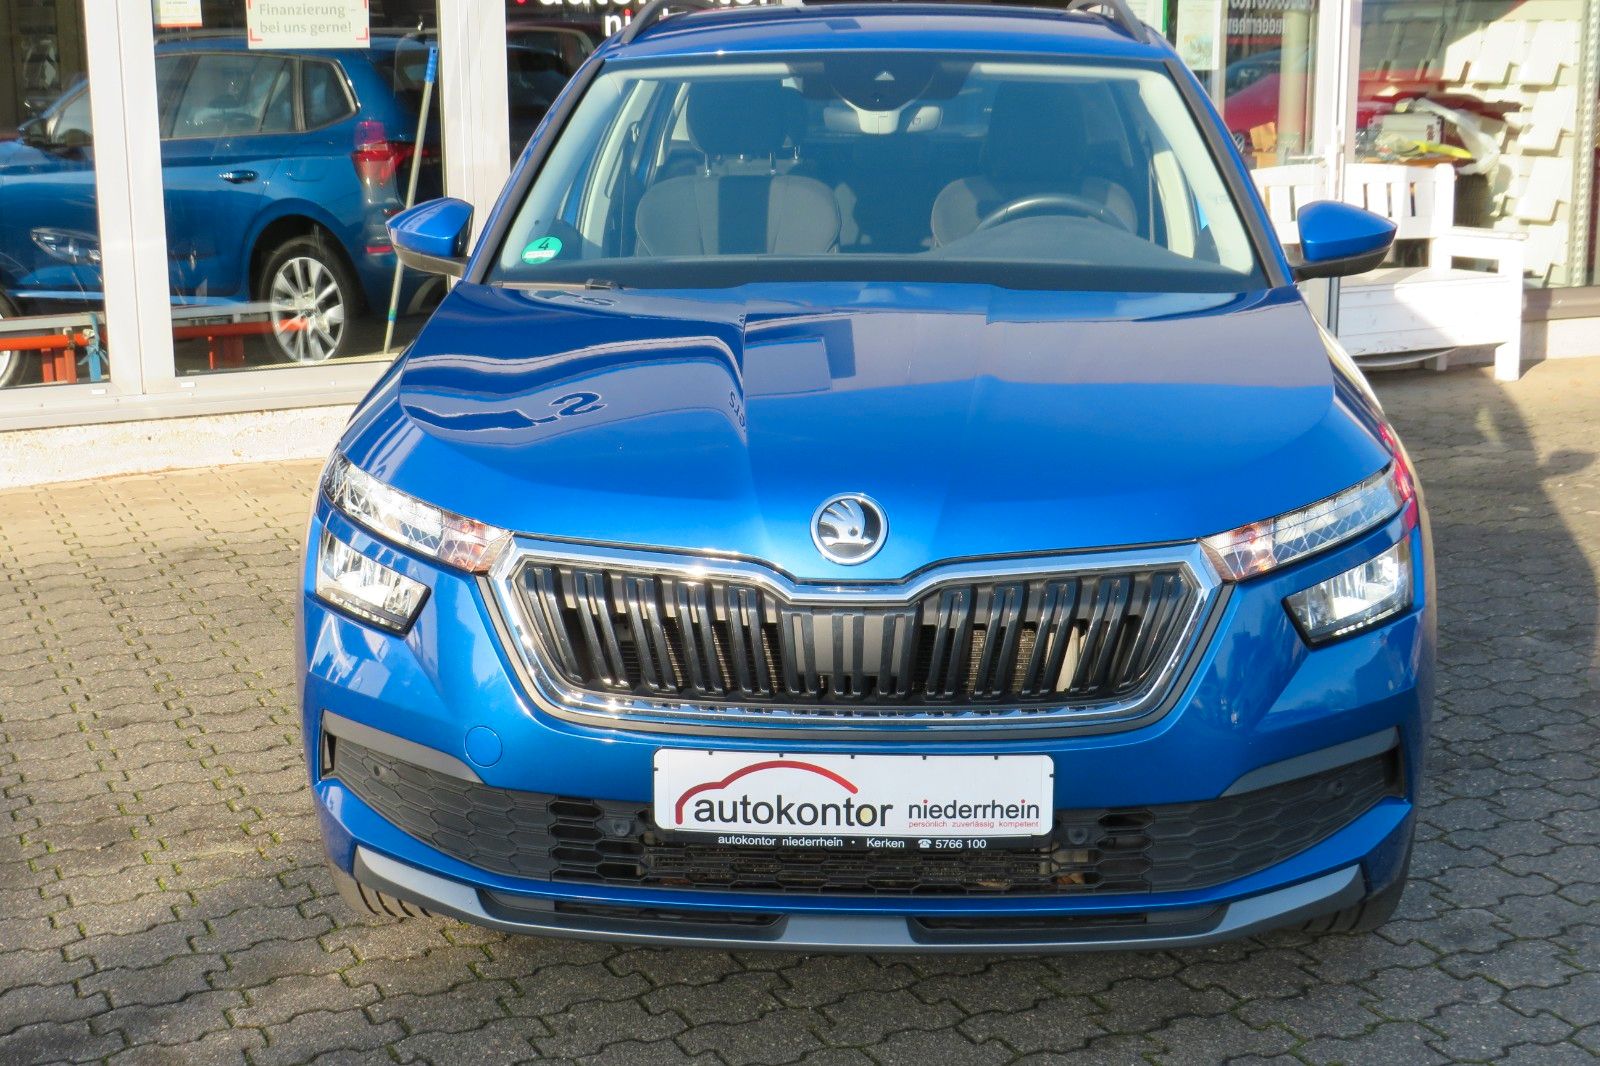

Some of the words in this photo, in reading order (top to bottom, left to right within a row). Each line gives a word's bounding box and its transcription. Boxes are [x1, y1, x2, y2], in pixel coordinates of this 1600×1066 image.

[258, 4, 346, 17] Finanzierung
[259, 21, 280, 33] bei
[284, 24, 306, 33] uns
[310, 22, 352, 37] gerne!
[538, 238, 550, 250] 4
[694, 794, 894, 827] autokontor
[908, 799, 1040, 819] niederrhein
[908, 820, 948, 829] persönlich
[951, 820, 995, 829] zuverlässig
[998, 820, 1039, 829] kompetent
[718, 834, 776, 846] autokontor
[782, 836, 843, 848] niederrhein
[866, 837, 905, 848] Kerken
[935, 839, 963, 849] 5766
[967, 839, 987, 849] 100
